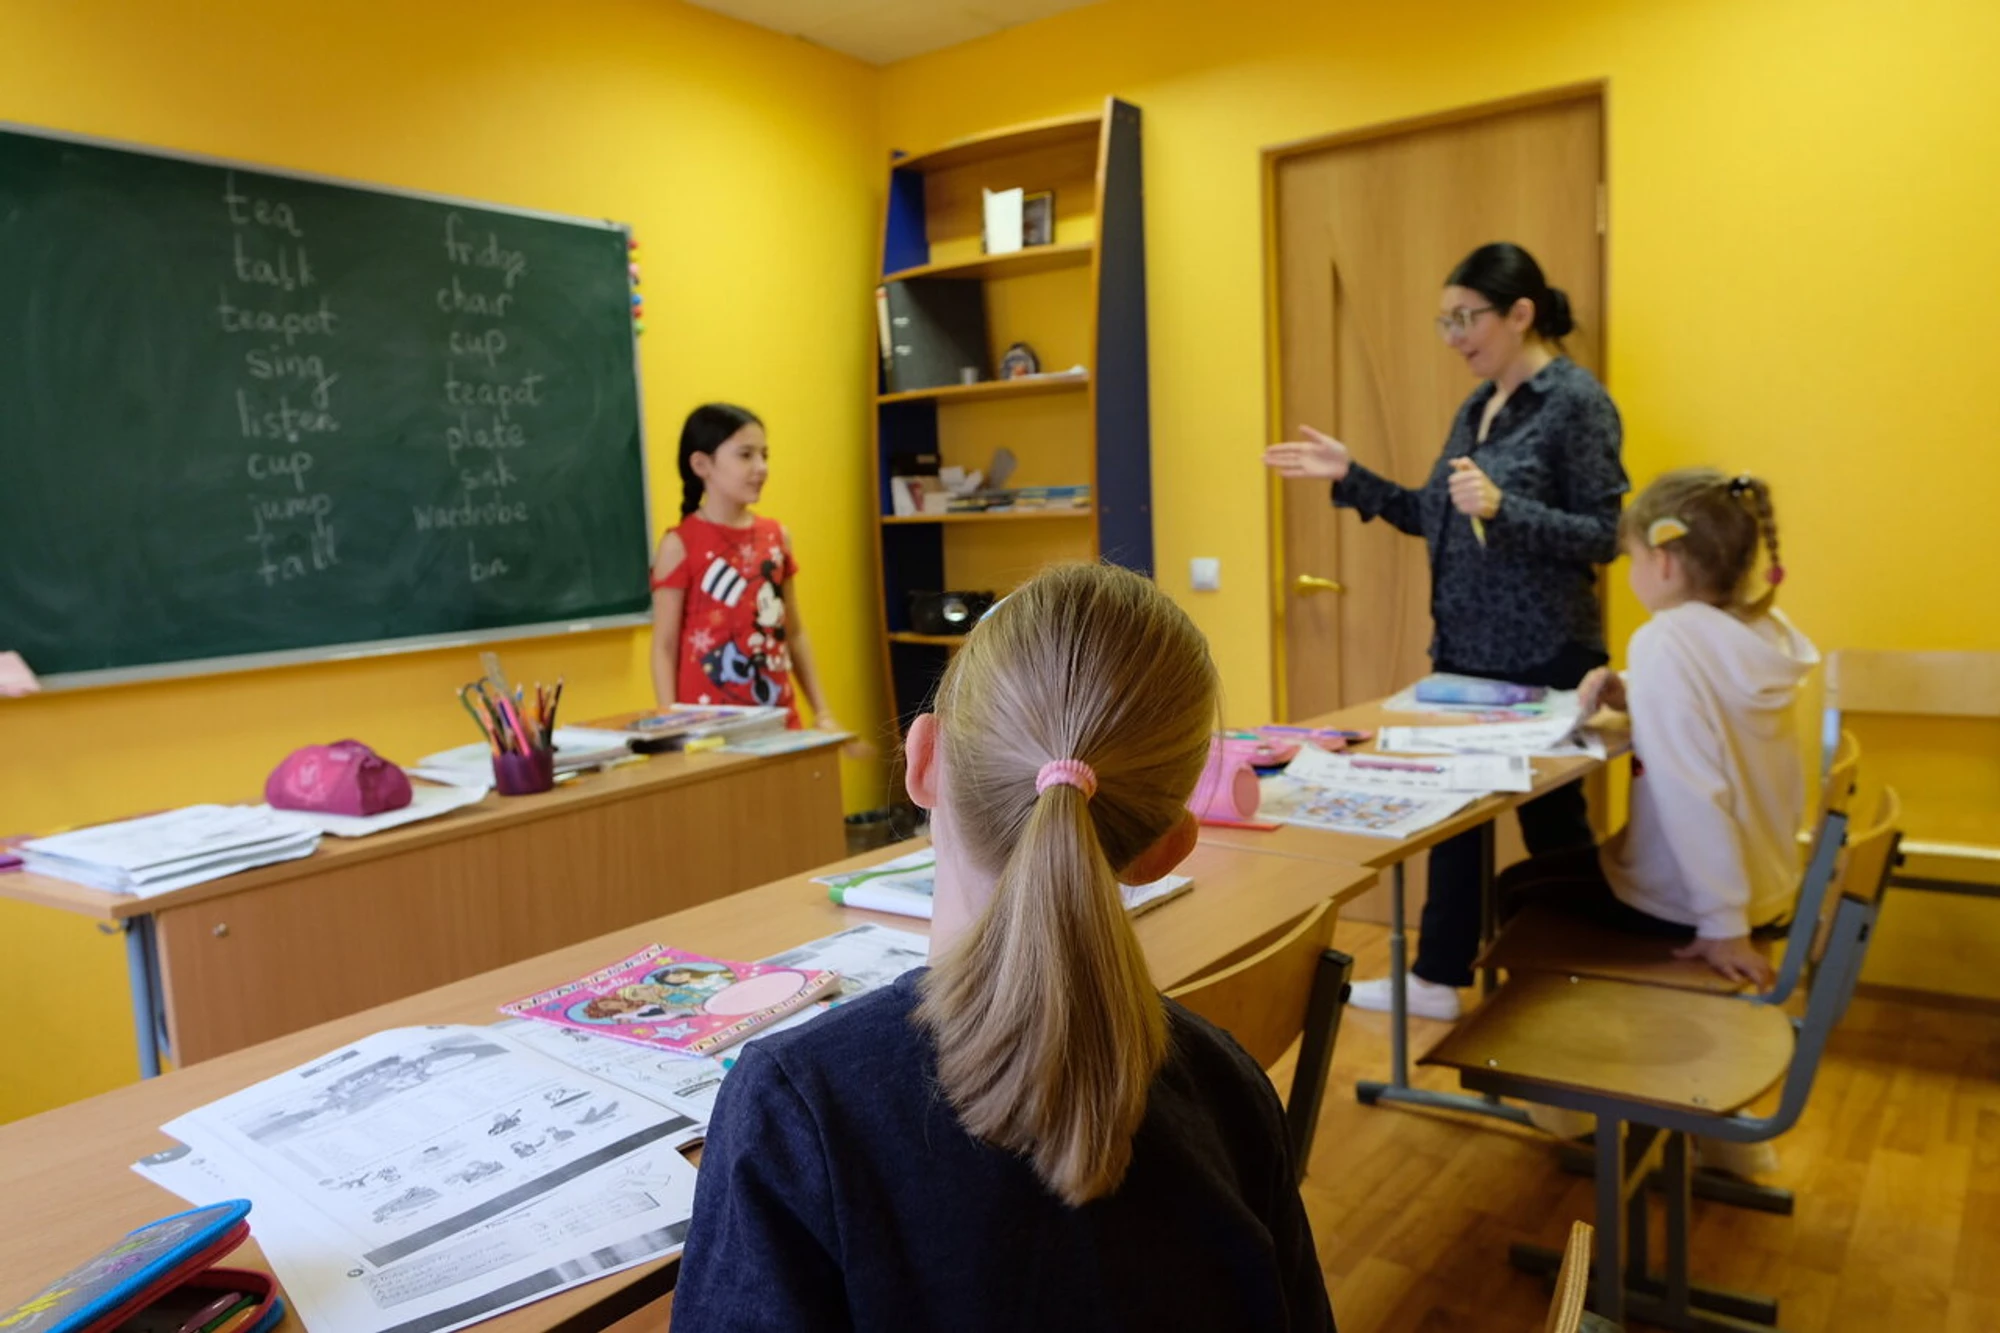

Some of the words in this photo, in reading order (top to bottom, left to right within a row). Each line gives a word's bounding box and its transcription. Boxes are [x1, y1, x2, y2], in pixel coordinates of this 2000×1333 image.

[222, 170, 304, 237] tea
[234, 233, 316, 290] talk
[216, 284, 340, 345] teapot
[437, 273, 514, 317] chair
[450, 329, 508, 368] cup
[244, 344, 340, 411] sing
[444, 361, 544, 421] teapot
[235, 388, 341, 443] listen
[446, 411, 526, 467] plate
[248, 452, 314, 492] cup
[246, 494, 331, 541] jump
